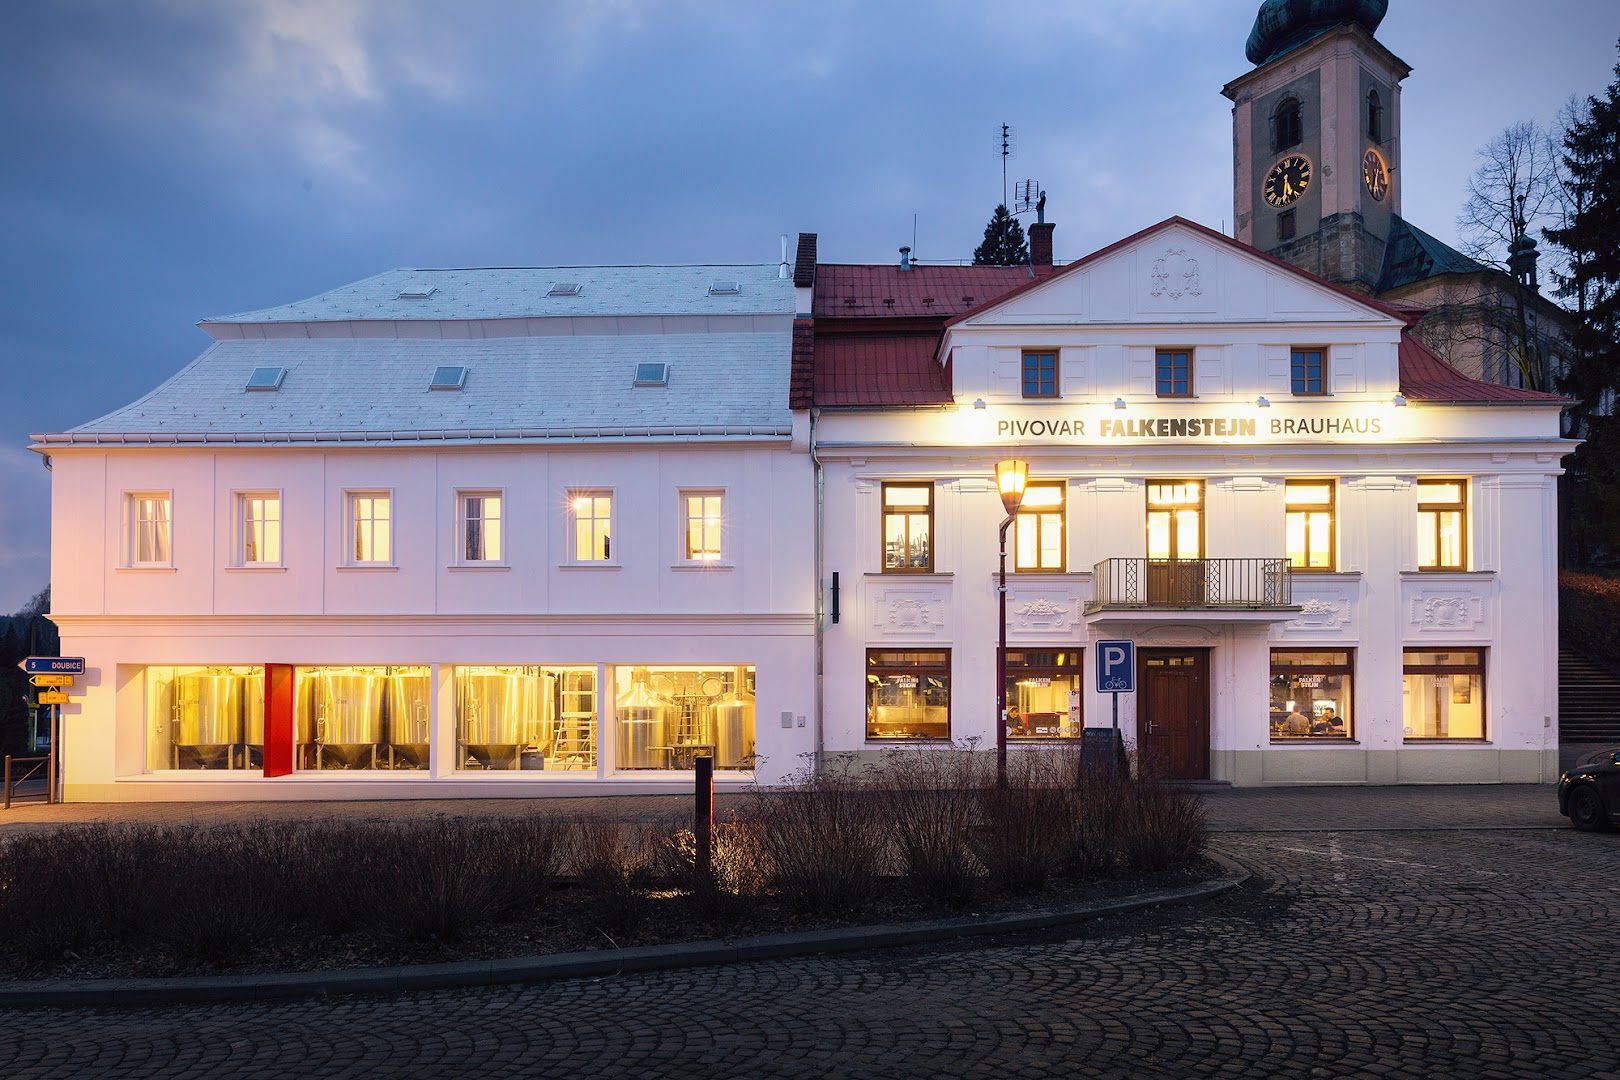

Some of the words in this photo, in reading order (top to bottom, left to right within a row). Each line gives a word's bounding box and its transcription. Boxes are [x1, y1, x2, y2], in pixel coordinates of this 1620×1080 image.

[998, 420, 1085, 436] PIVOVAR
[1100, 418, 1256, 437] FALKENSTEJN
[1270, 418, 1381, 434] BRAUHAUS
[1105, 647, 1125, 676] P
